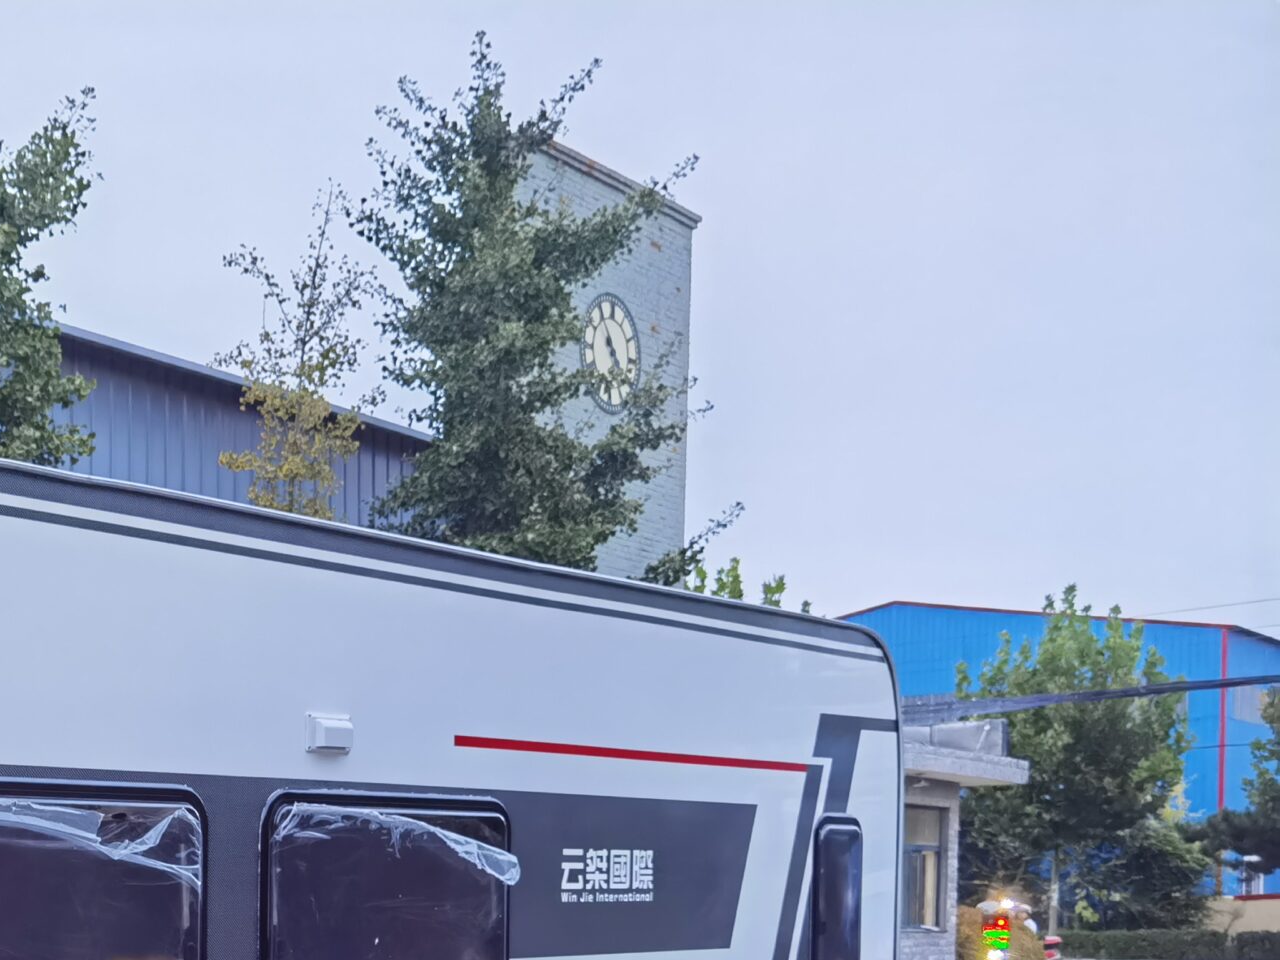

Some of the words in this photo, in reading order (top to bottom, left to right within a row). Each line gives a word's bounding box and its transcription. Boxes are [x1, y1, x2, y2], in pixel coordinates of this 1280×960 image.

[561, 892, 578, 903] Win
[580, 892, 594, 902] Jie
[596, 891, 653, 902] International
